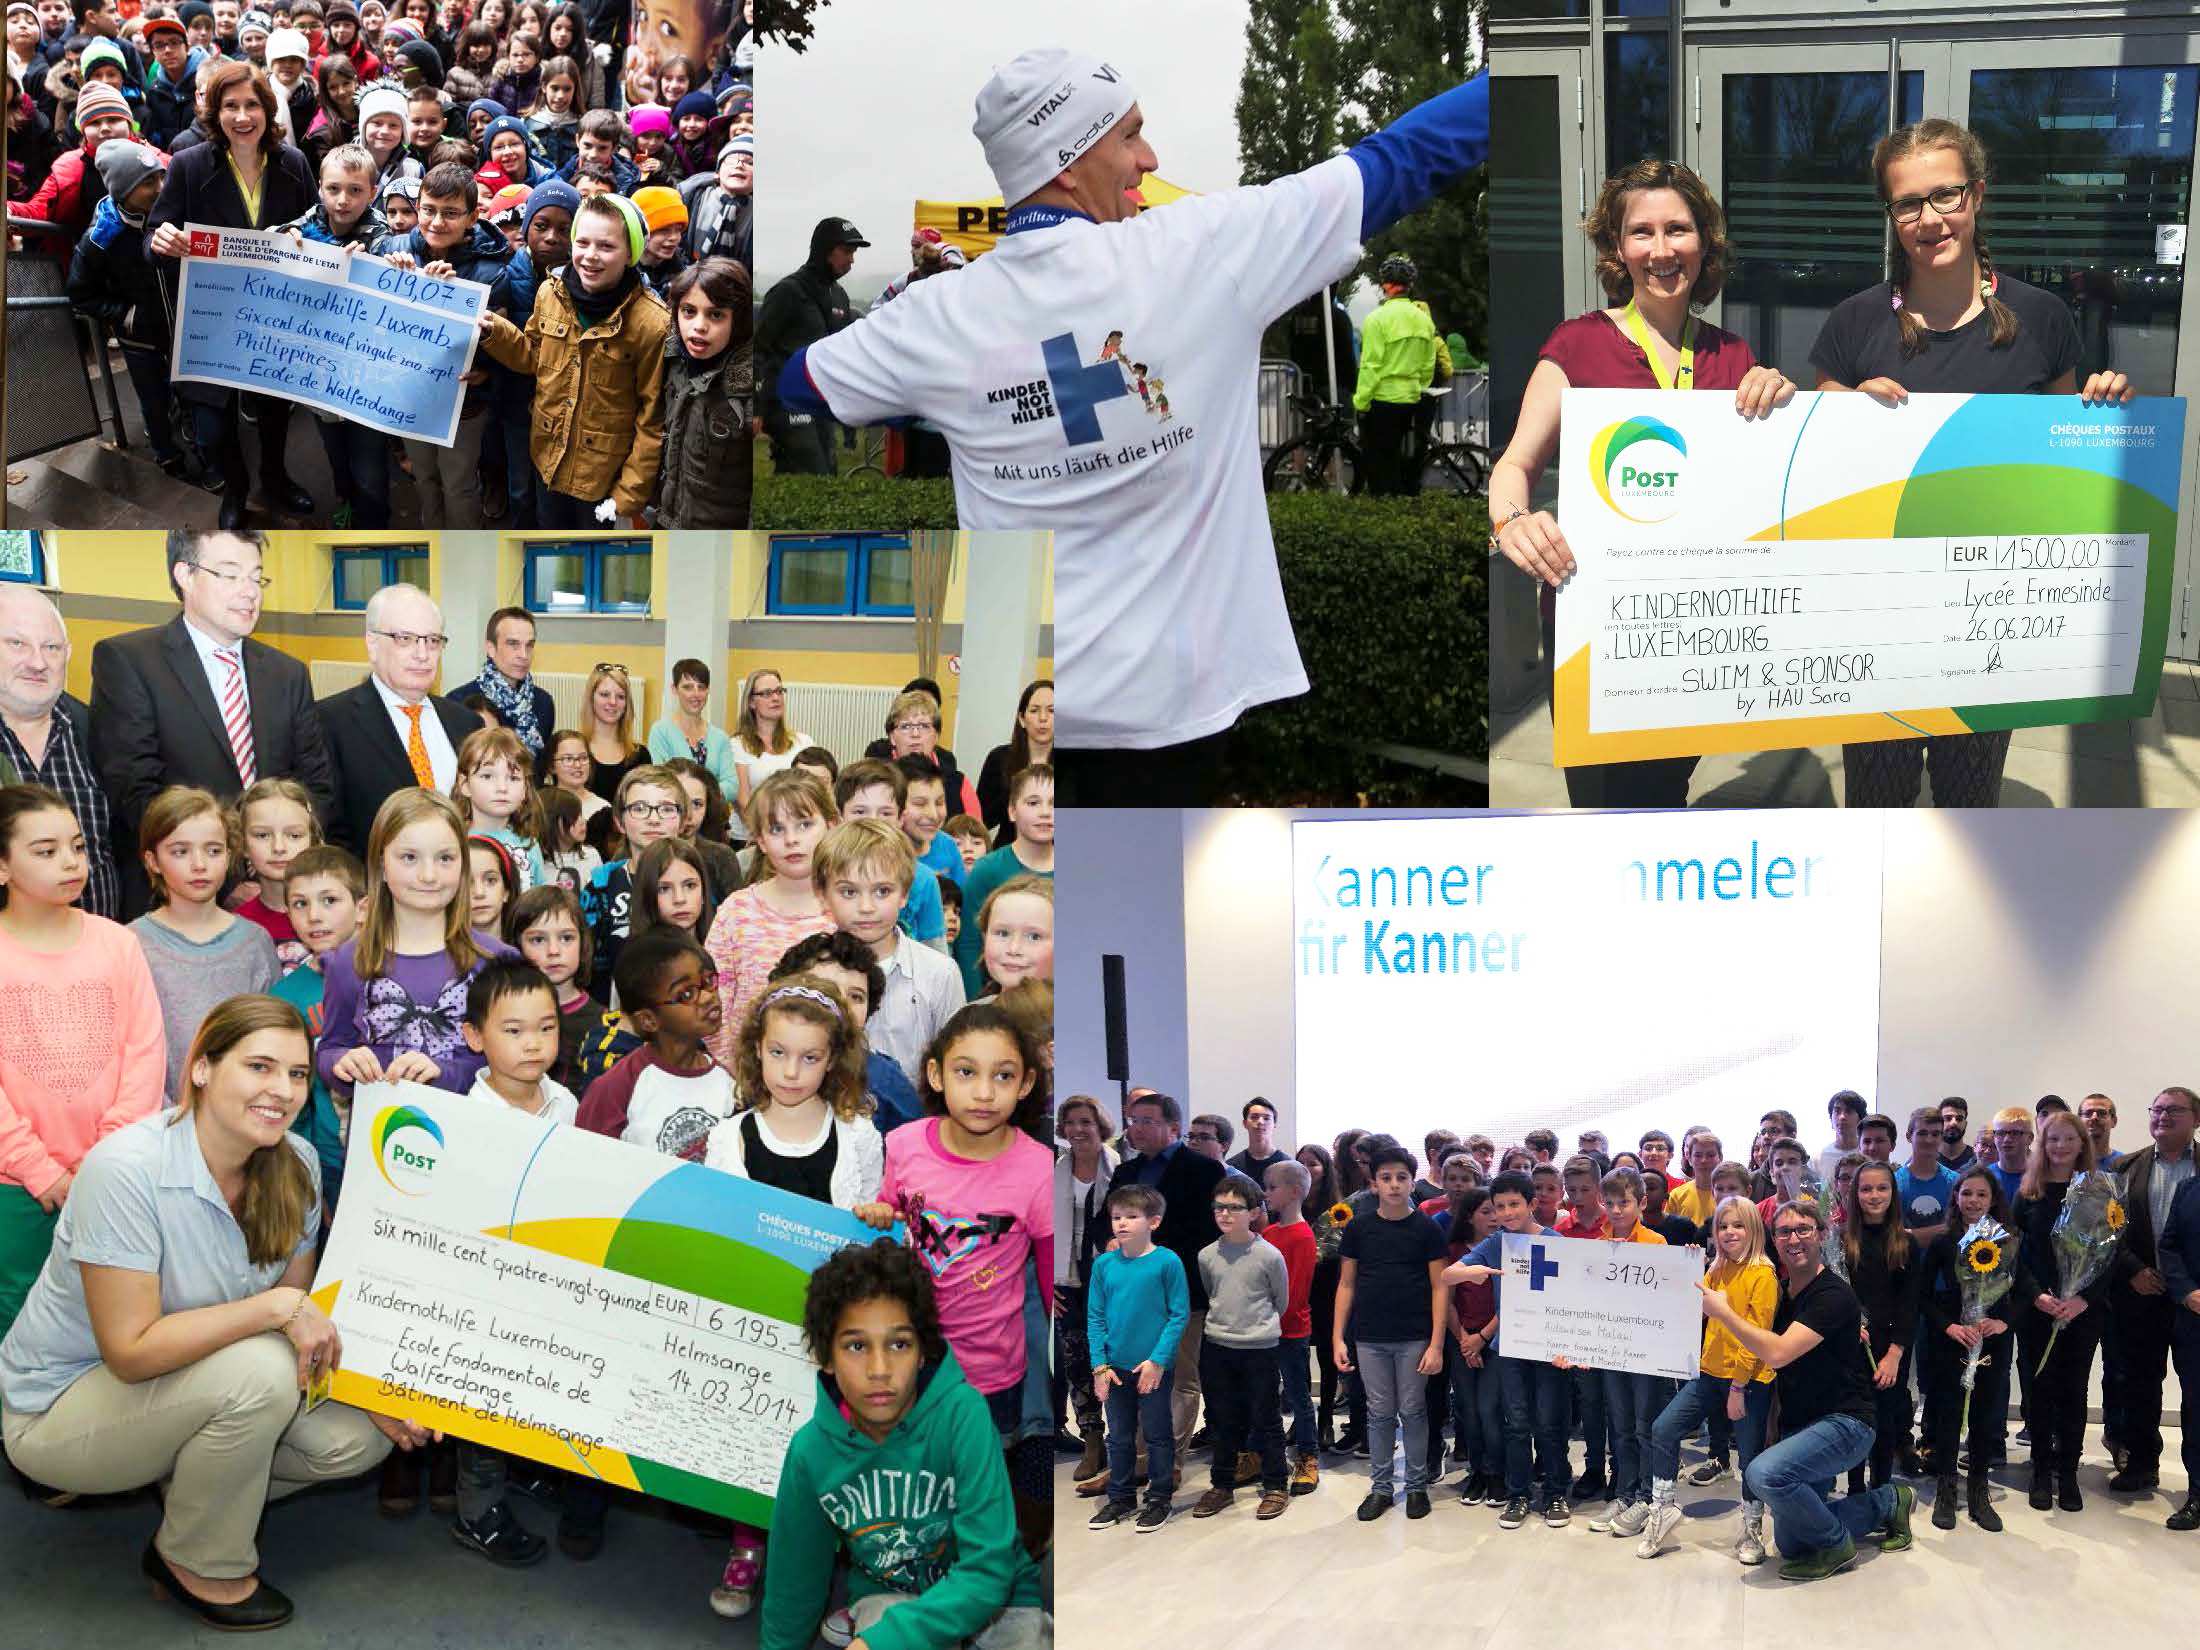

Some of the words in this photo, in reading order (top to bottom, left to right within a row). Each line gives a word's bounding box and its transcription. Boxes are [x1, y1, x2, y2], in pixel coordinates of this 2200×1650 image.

[222, 243, 253, 252] CAISSE
[254, 246, 301, 261] D'EPARGNE
[303, 255, 314, 264] DE
[315, 258, 340, 270] L'ETAT
[222, 251, 280, 264] LUXEMBOURG
[223, 236, 261, 247] BANQUE
[377, 268, 456, 307] 619,07
[465, 298, 476, 307] €
[235, 306, 261, 323] Six
[297, 319, 320, 338] dix
[356, 339, 397, 362] virgule
[234, 329, 337, 373] Philippines
[249, 358, 294, 384] Ecole
[300, 372, 319, 390] de
[326, 376, 416, 424] Walferdange
[987, 380, 1048, 403] KINDER
[1017, 392, 1050, 411] NOT
[1011, 404, 1055, 425] HILFE
[2104, 425, 2156, 435] POSTAUX
[994, 465, 1023, 480] Mit
[1029, 464, 1062, 480] uns
[1066, 453, 1112, 476] läuft
[1117, 445, 1147, 465] die
[1152, 425, 1194, 455] Hilfe
[2049, 438, 2083, 447] L-1090
[2086, 438, 2155, 448] LUXEMBOURG
[1953, 546, 1988, 562] EUR
[2001, 537, 2100, 571] 1500,00
[1612, 587, 1803, 620] KINDERNOTHILFE
[2027, 577, 2112, 604] Ermesinde
[1614, 625, 1769, 660] LUXEMBOURG
[1621, 622, 1649, 631] toutes
[1964, 615, 2068, 641] 26.06.2017
[1682, 663, 1750, 693] SWIM
[1762, 662, 1777, 687] &
[1785, 653, 1874, 686] SPONSOR
[1737, 693, 1756, 718] by
[1768, 688, 1803, 710] HAU
[1809, 686, 1851, 705] Sara
[1364, 919, 1528, 975] Kanner
[402, 1229, 447, 1254] mille
[453, 1245, 488, 1266] cent
[655, 1293, 689, 1316] EUR
[709, 1308, 724, 1331] 6
[1607, 1311, 1665, 1329] Luxembourg
[356, 1281, 478, 1332] Kindernothilfe
[488, 1316, 606, 1379] Luxembourg
[398, 1326, 440, 1358] Ecole
[568, 1381, 592, 1404] de
[664, 1332, 773, 1387] Helmsange
[391, 1352, 513, 1409] Walferdange
[668, 1369, 800, 1423] 14.03.2014
[378, 1373, 468, 1414] Bâtiment
[475, 1403, 500, 1423] de
[504, 1408, 605, 1457] Helmsange
